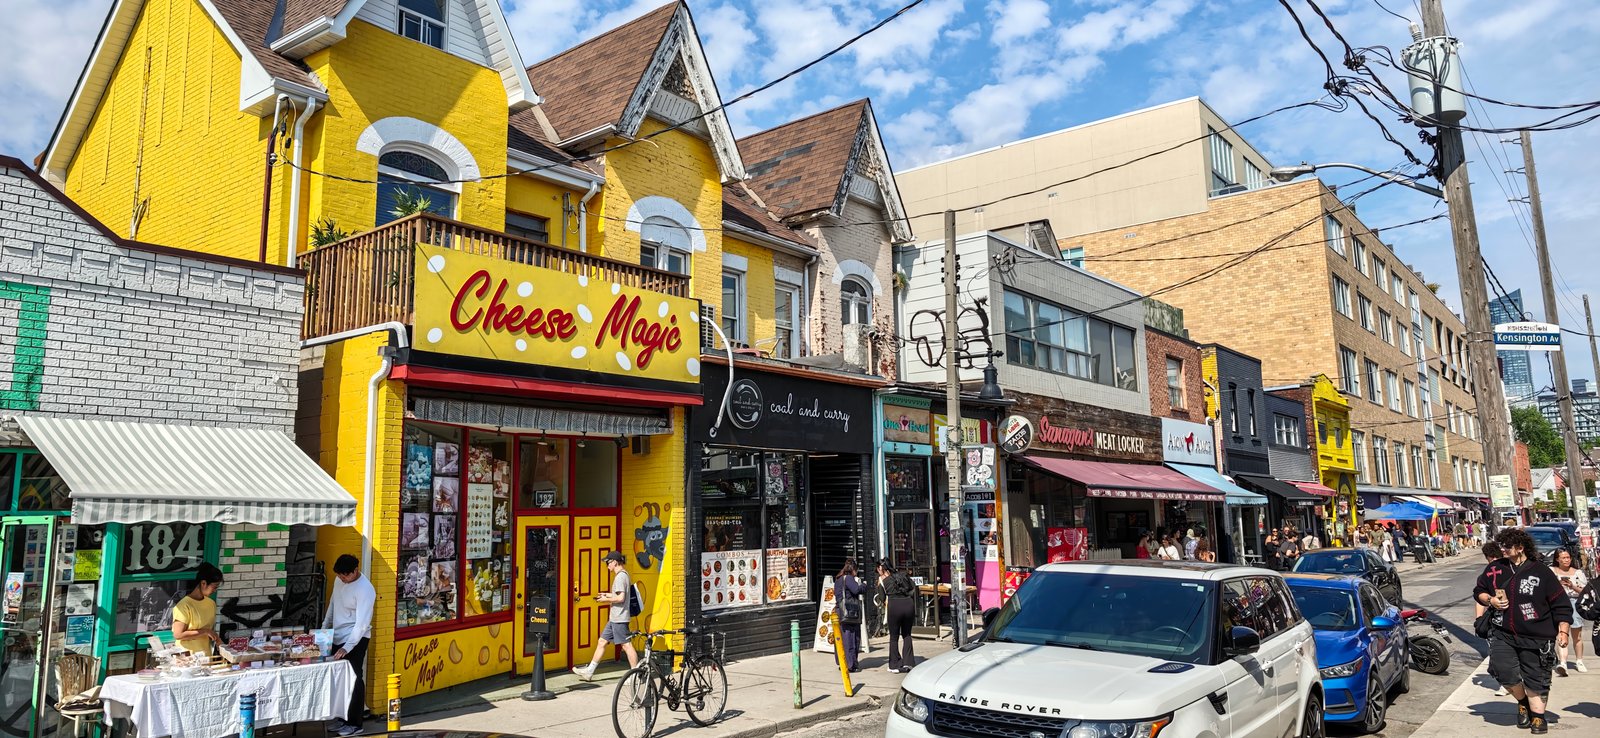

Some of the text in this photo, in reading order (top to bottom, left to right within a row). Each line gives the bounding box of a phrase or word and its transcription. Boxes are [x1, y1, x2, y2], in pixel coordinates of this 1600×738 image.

[450, 269, 683, 370] Cheese Magic
[1497, 333, 1548, 344] Kensington
[770, 392, 851, 433] coal and curry
[1007, 428, 1027, 446] TACOS
[1038, 415, 1145, 454] Sanagan's MEAT LOCKER
[126, 524, 204, 571] 184
[716, 551, 745, 559] COMBOS
[534, 606, 547, 614] C'est
[403, 637, 440, 670] Cheese
[414, 655, 445, 692] Magic
[939, 692, 1061, 715] RANGE ROVER
